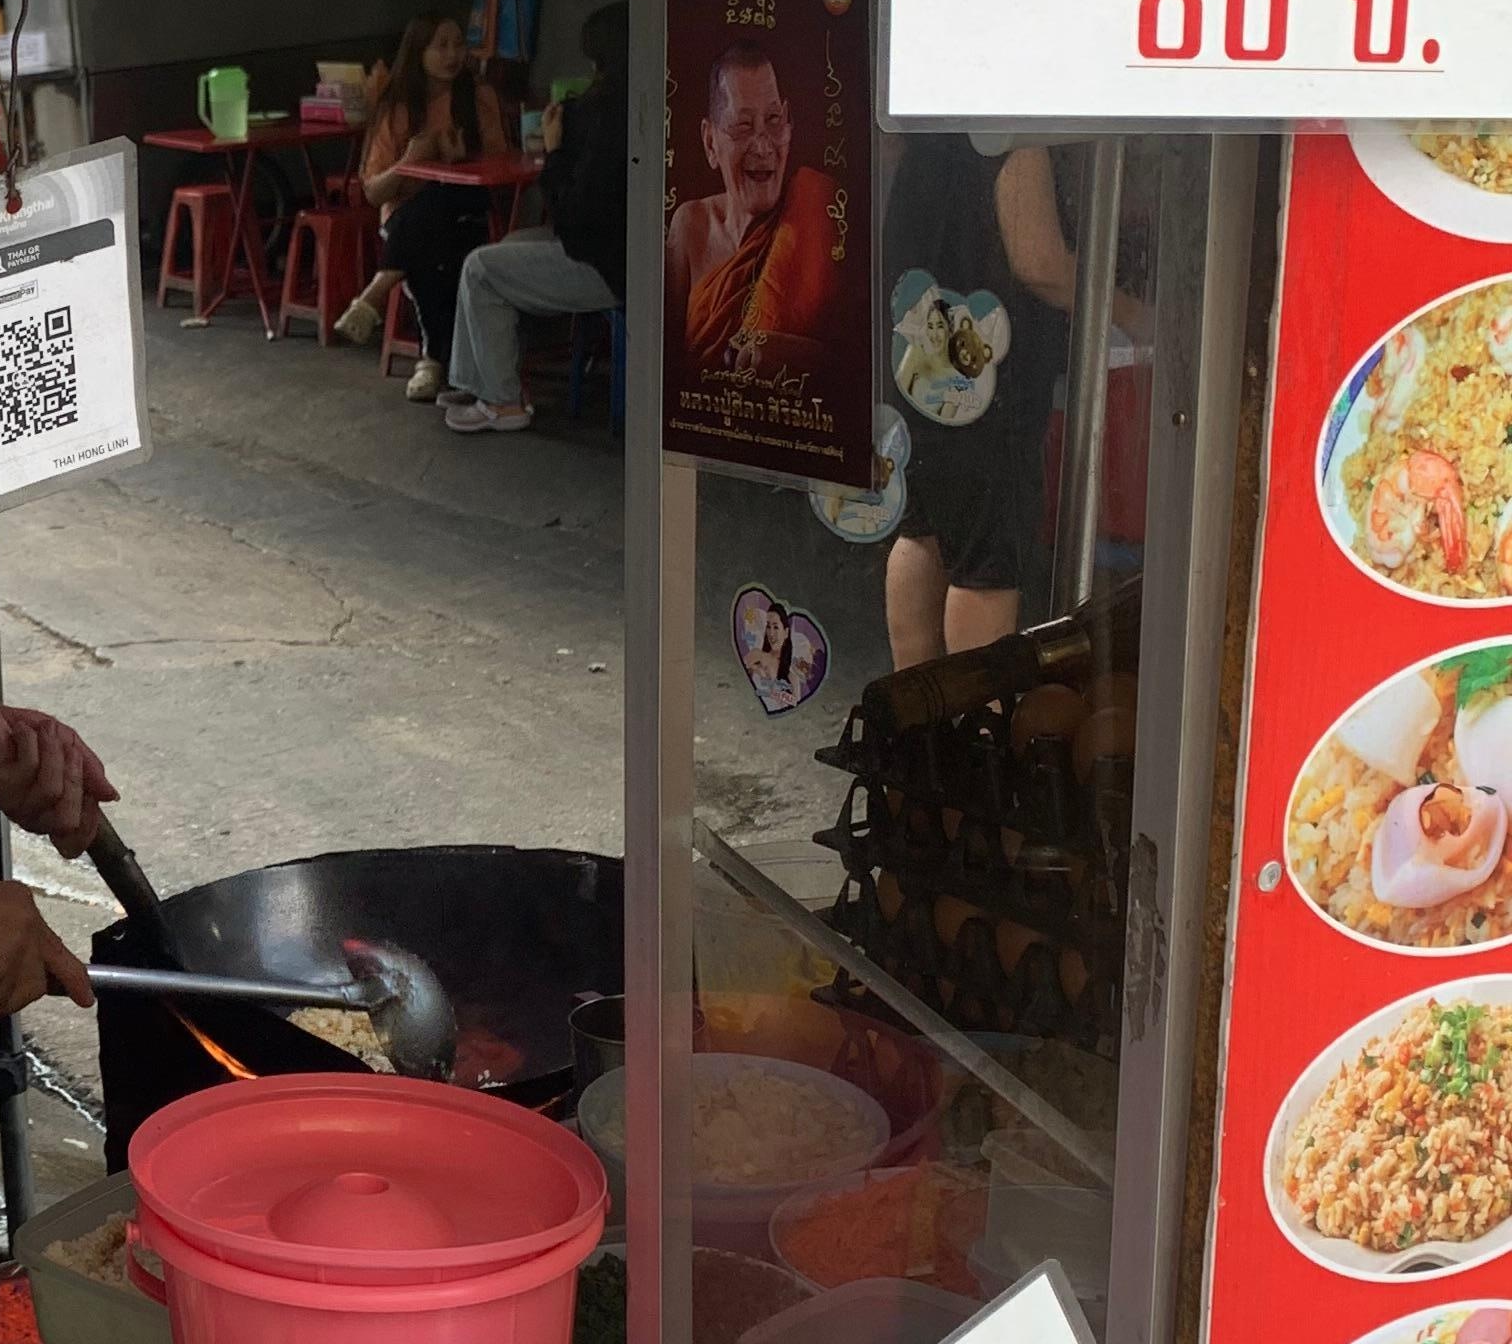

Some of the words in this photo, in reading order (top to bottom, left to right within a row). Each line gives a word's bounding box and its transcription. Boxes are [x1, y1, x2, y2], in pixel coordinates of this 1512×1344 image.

[7, 248, 27, 261] THAI
[28, 244, 41, 256] QR
[7, 252, 41, 269] PAYMENT
[52, 454, 76, 469] THAI
[78, 443, 106, 462] HONG
[106, 436, 130, 453] LINH
